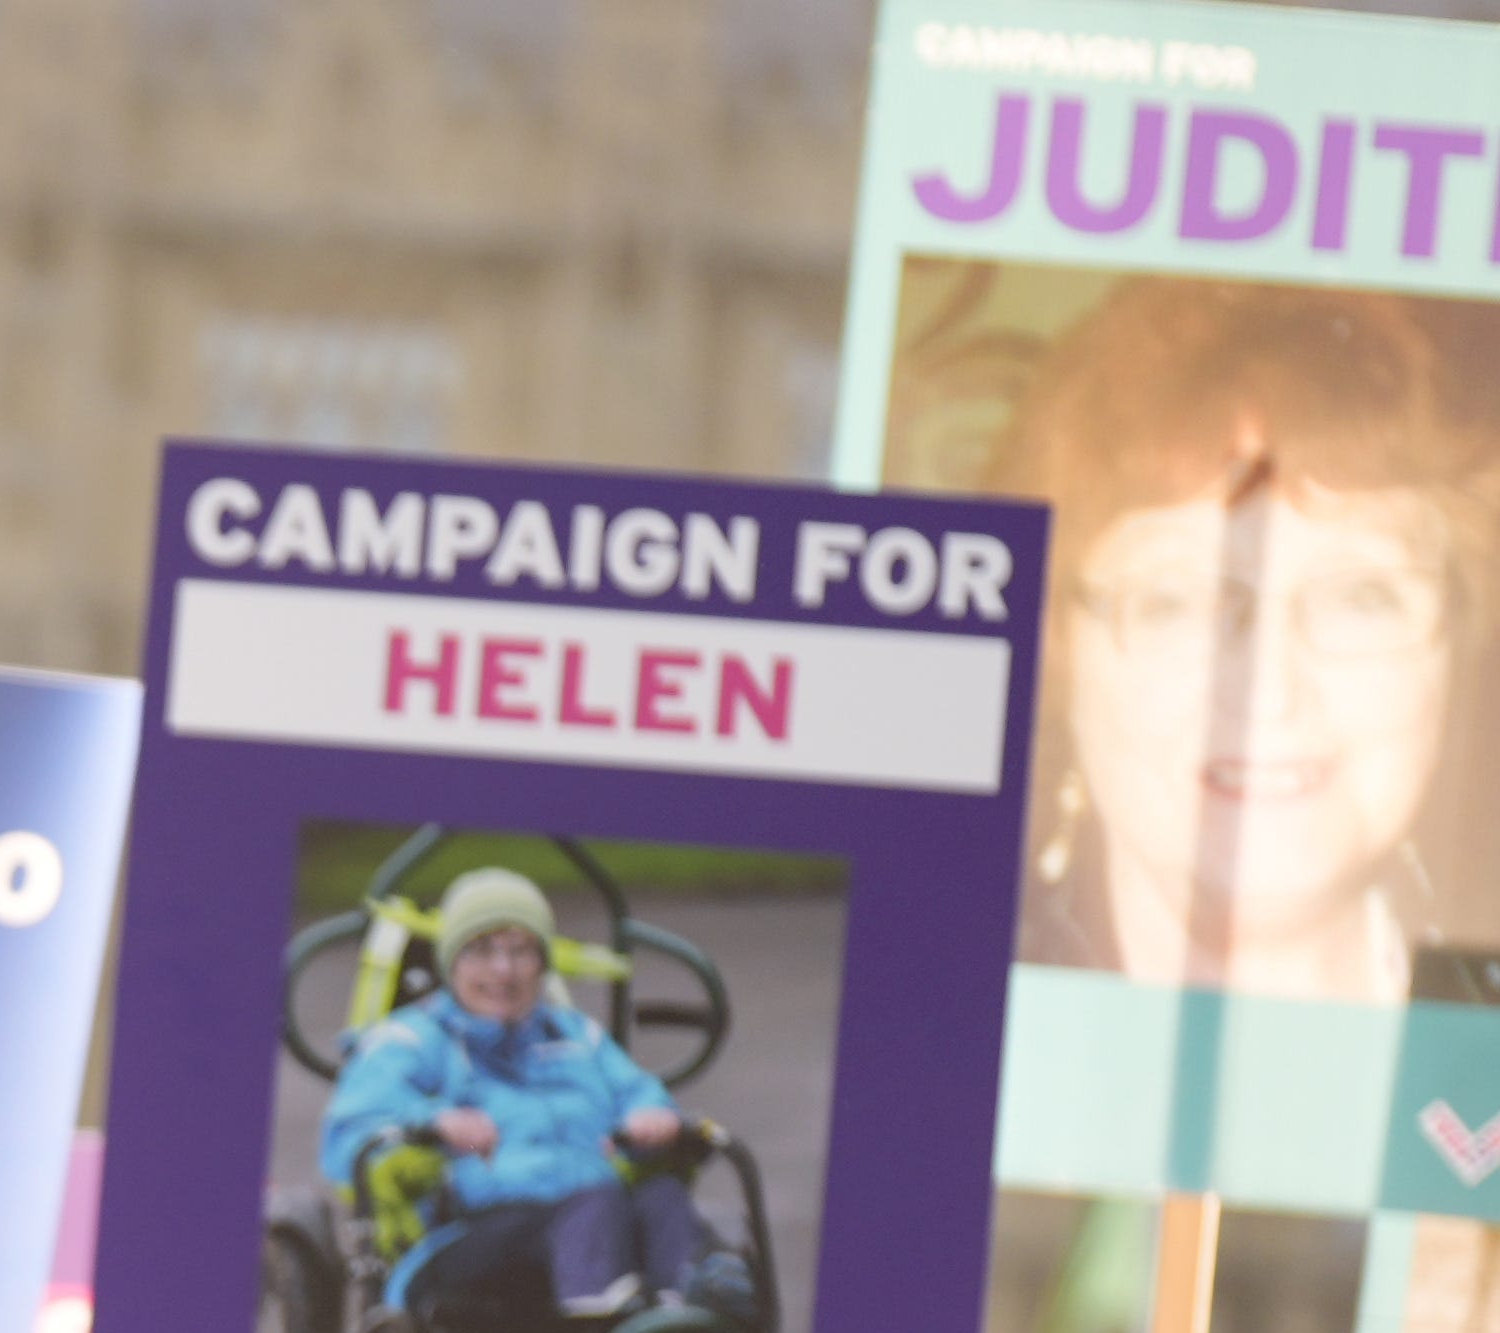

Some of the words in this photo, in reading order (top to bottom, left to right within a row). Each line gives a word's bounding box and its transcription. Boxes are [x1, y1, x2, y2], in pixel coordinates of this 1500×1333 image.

[911, 88, 1500, 268] JUDIT
[185, 475, 761, 607] CAMPAIGN
[794, 517, 1014, 620] FOR
[380, 628, 795, 744] HELEN
